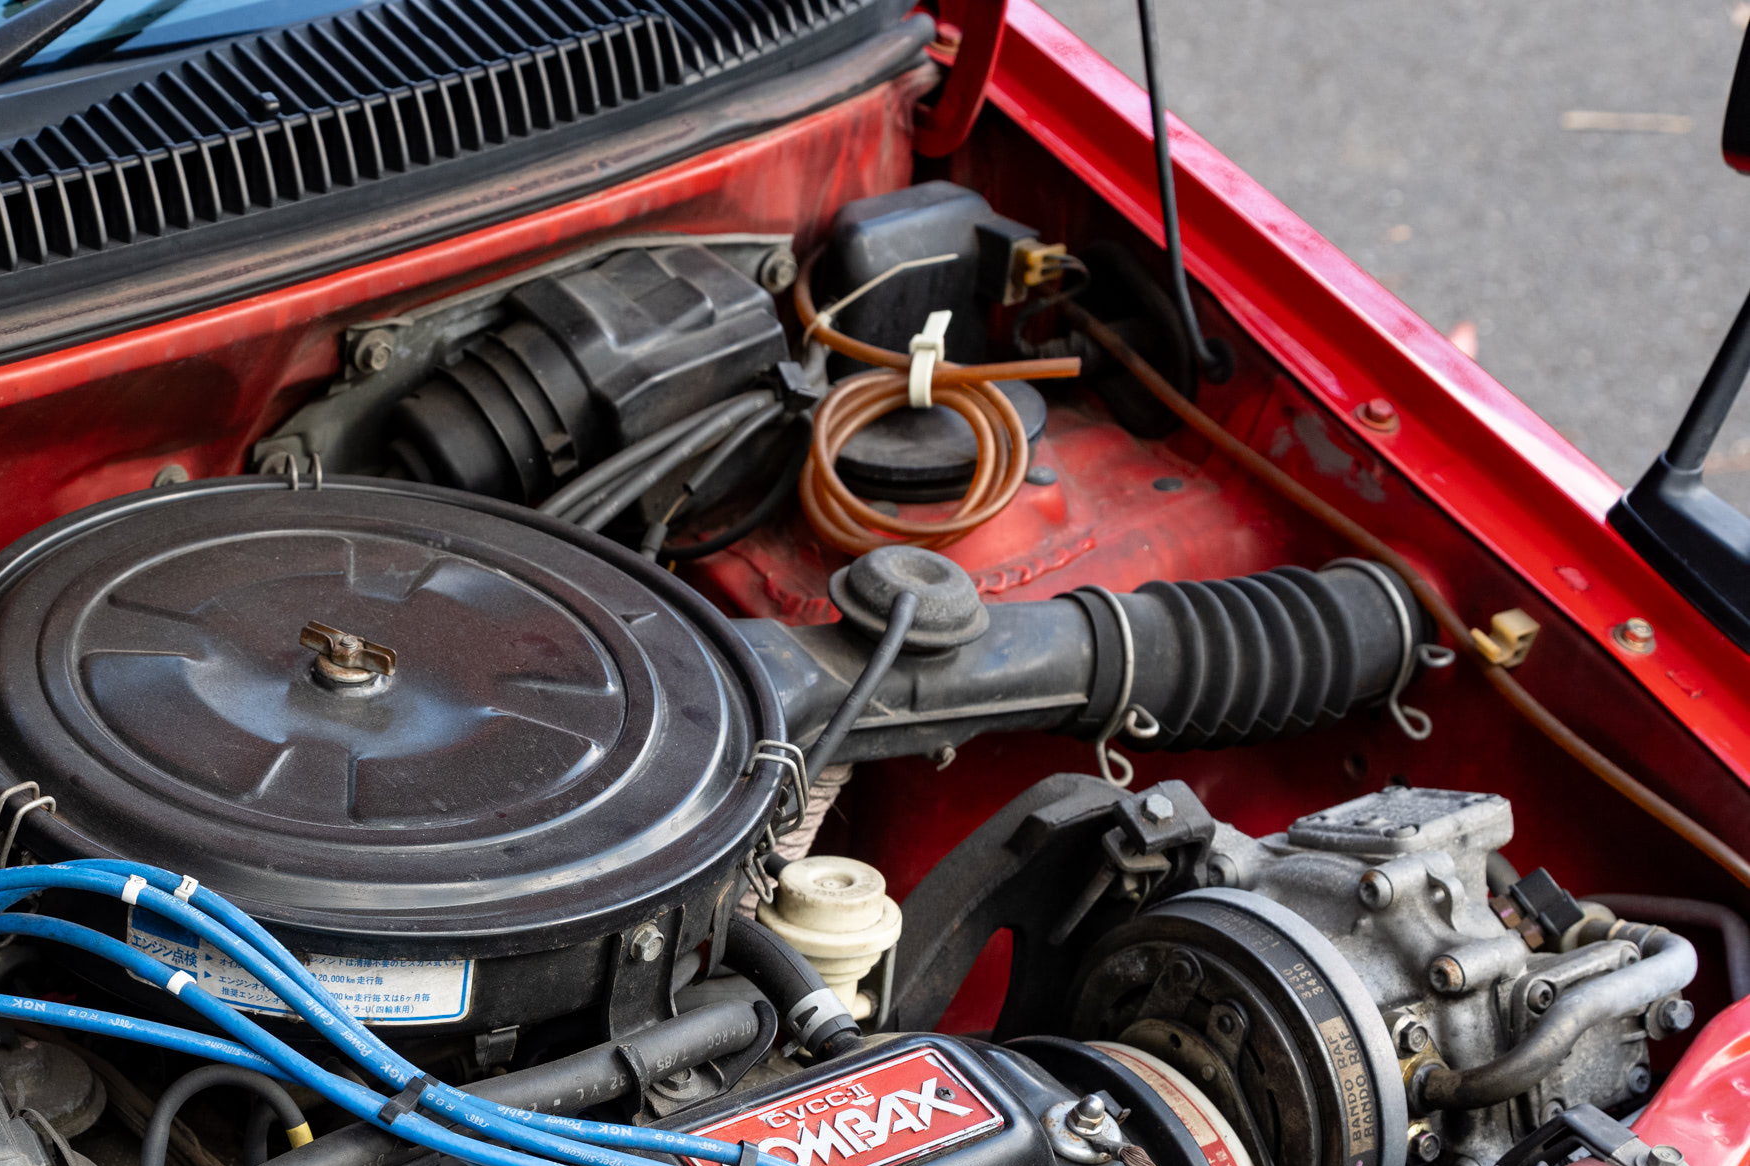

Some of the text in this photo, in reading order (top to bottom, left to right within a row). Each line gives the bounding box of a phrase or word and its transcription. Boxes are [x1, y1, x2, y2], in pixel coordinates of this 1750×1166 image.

[132, 934, 197, 968] エンジン点検
[264, 964, 287, 982] Japan
[318, 973, 345, 985] 20,000
[1293, 962, 1324, 995] 3430
[1282, 968, 1312, 999] 3430
[12, 998, 47, 1012] NGK
[304, 1000, 334, 1026] Cable
[340, 1030, 372, 1057] Power
[379, 1062, 410, 1084] NGK
[445, 1087, 470, 1101] Japan
[1327, 1036, 1362, 1142] BANDO RAF
[1340, 1030, 1375, 1138] BANDO RAF
[424, 1093, 456, 1111] R09
[765, 1082, 873, 1130] CVCC-II
[497, 1105, 533, 1120] Cable
[544, 1116, 583, 1131] Power
[598, 1123, 633, 1138] NGK
[654, 1132, 686, 1145] R09
